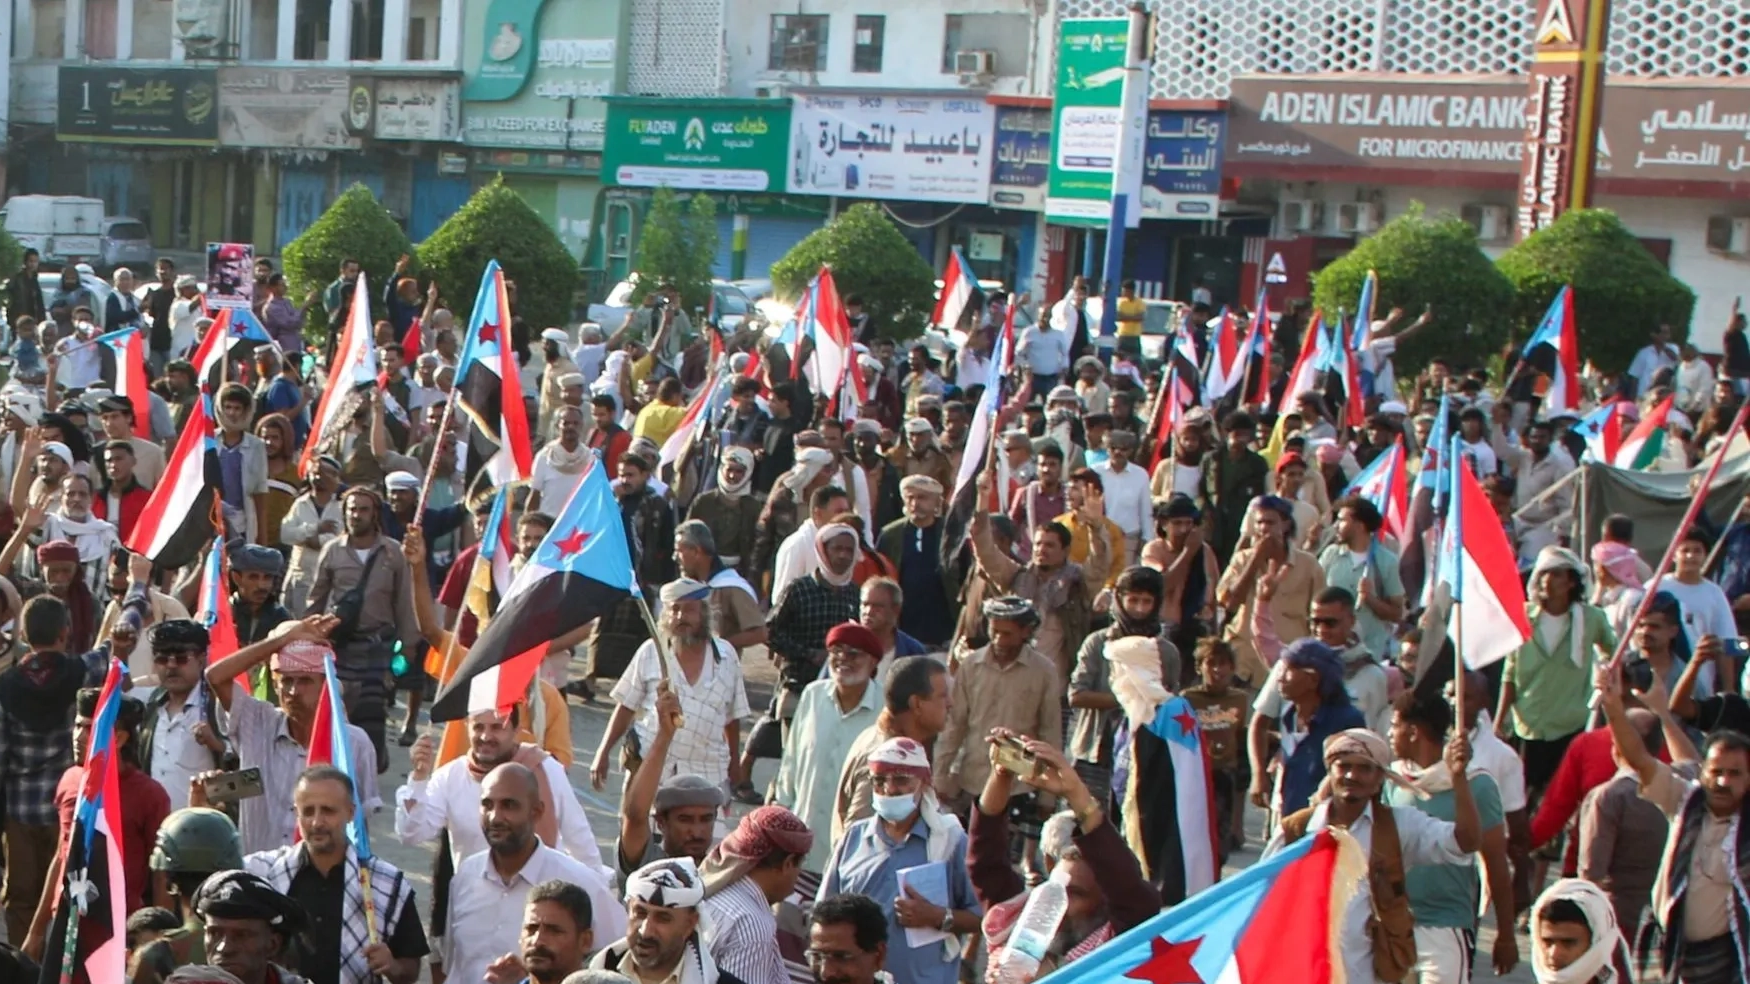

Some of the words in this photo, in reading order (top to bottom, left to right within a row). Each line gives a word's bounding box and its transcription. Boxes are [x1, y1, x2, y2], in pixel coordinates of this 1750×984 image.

[1260, 91, 1333, 124] ADEN
[1339, 93, 1444, 127] ISLAMIC
[1447, 96, 1528, 129] BANK
[1546, 74, 1568, 144] BANK
[819, 120, 896, 160] للتجارة
[1147, 115, 1220, 145] وكالة
[1358, 136, 1393, 157] FOR
[1396, 139, 1524, 161] MICROFINANCE
[1538, 148, 1560, 231] SLAMIC
